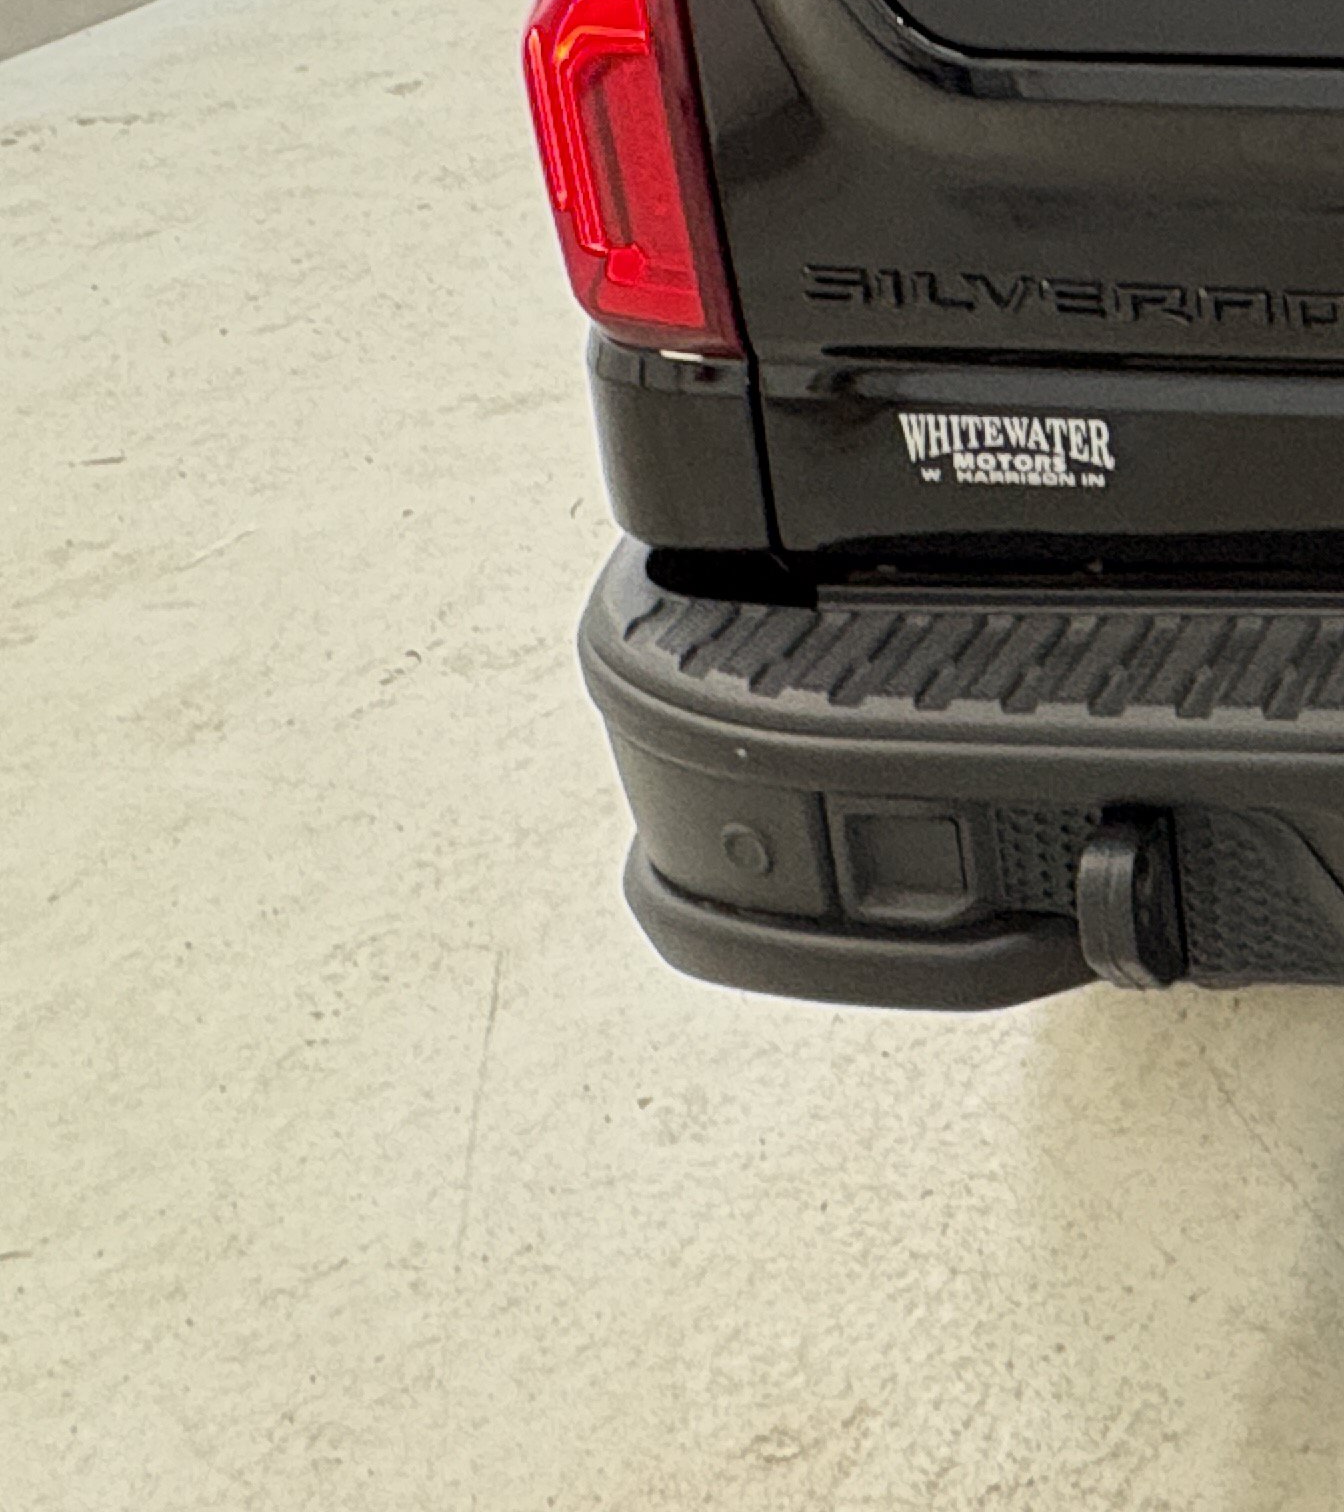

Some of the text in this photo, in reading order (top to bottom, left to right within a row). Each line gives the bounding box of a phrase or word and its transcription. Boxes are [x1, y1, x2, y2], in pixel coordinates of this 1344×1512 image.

[899, 413, 1115, 471] WHITEWATER
[953, 452, 1068, 473] MOTORS
[956, 470, 1076, 487] HARRISON
[1080, 473, 1106, 487] IN
